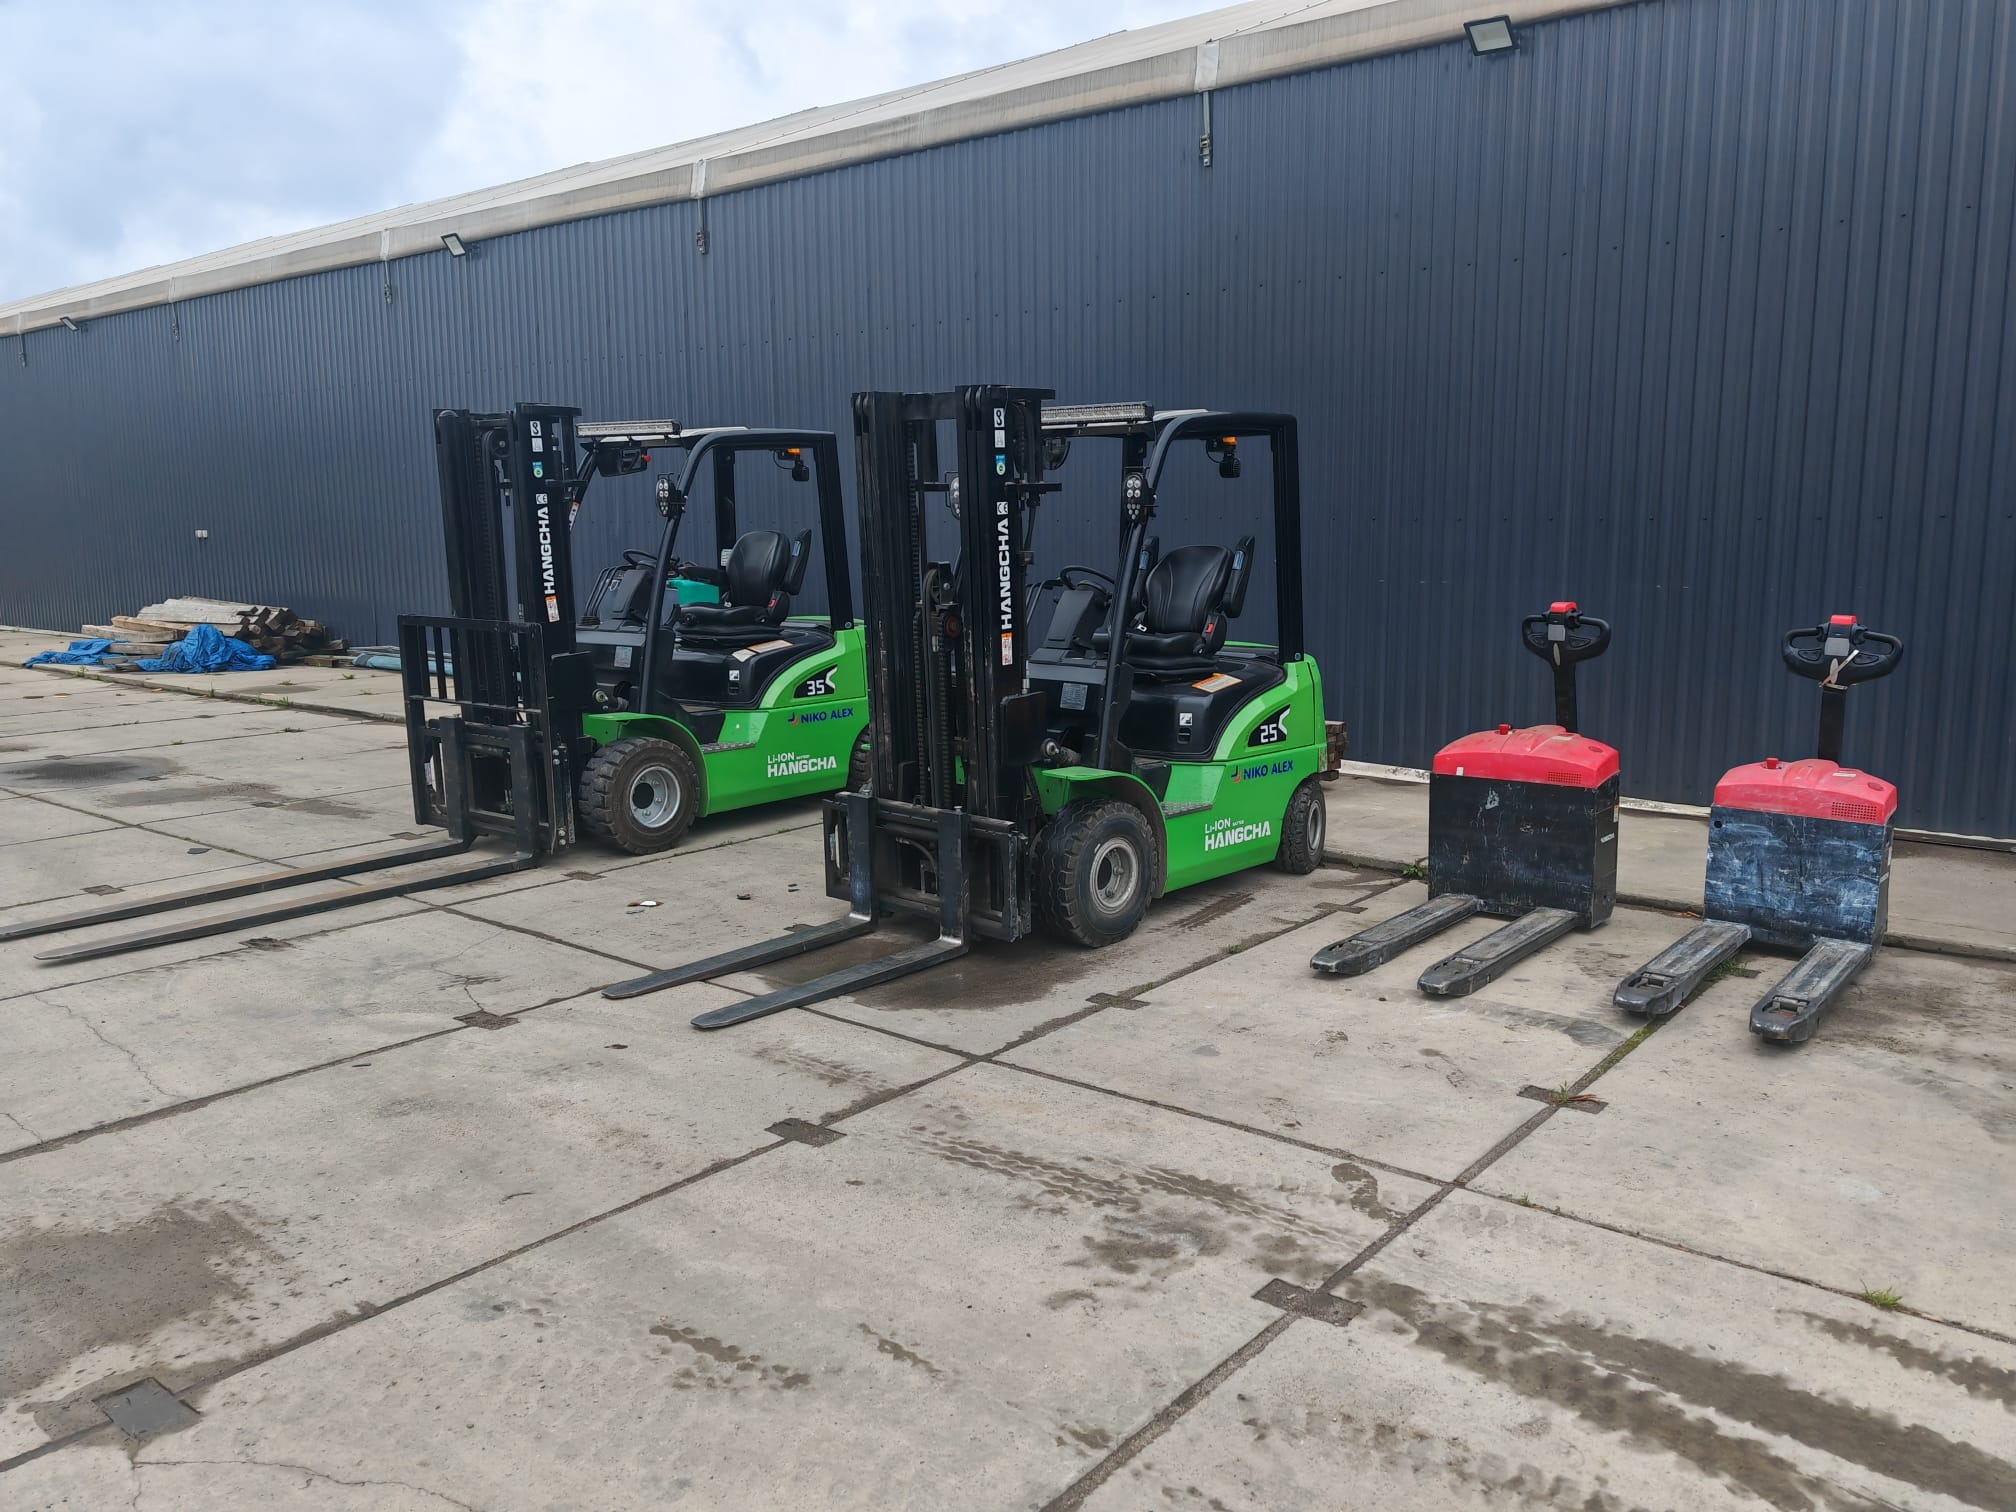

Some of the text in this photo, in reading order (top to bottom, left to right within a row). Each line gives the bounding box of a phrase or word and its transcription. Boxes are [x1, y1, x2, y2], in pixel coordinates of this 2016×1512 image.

[537, 506, 556, 595] HANGCHA
[997, 517, 1012, 630] HANGCHA
[806, 680, 825, 695] 35
[801, 707, 854, 723] NIKO ALEX
[1260, 724, 1278, 743] 25
[767, 756, 837, 778] HANGCHA
[1243, 760, 1294, 780] NIKO ALEX
[1204, 820, 1271, 851] HANGCHA
